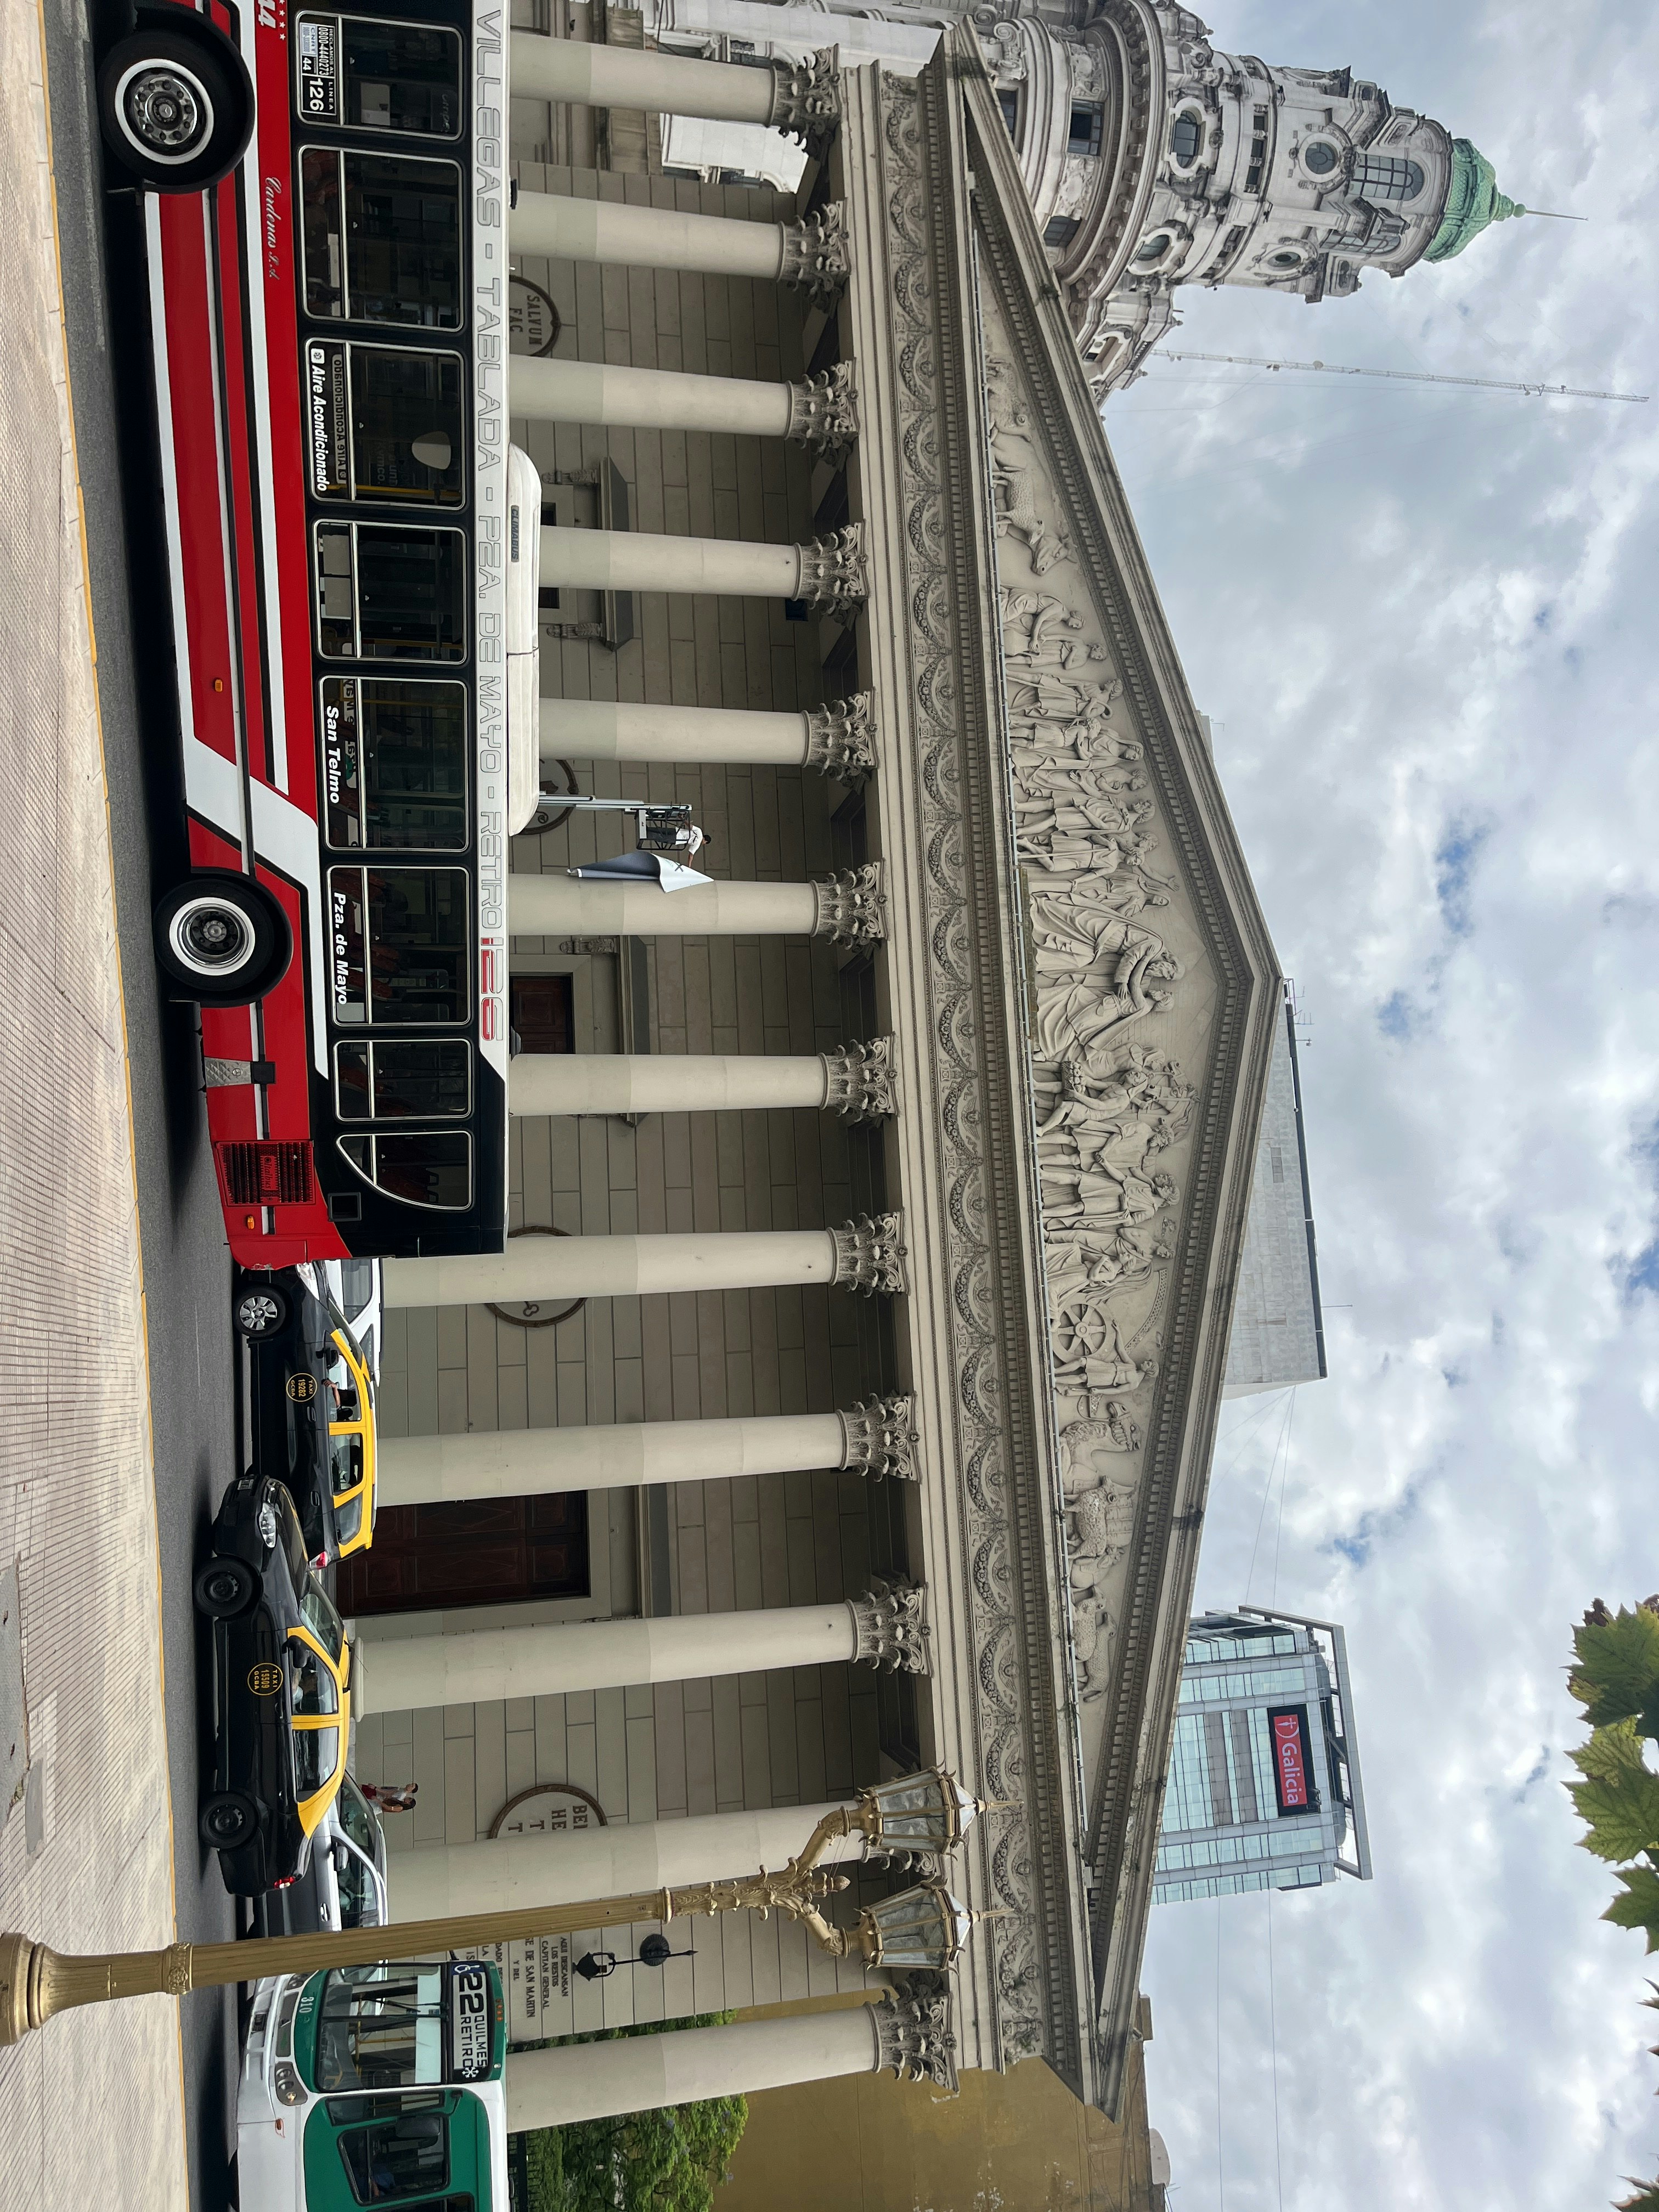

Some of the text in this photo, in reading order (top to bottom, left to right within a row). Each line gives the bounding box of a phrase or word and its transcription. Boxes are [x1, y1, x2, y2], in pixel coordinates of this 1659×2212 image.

[302, 57, 312, 71] 44
[318, 27, 329, 76] 0800-4440273
[329, 66, 335, 75] AL
[309, 77, 324, 111] 126
[476, 9, 501, 228] VILLEGAS
[264, 177, 282, 248] Cardenas
[509, 307, 524, 333] FAC
[477, 277, 501, 472] TABLADA
[312, 365, 330, 492] Aire Acondicionado
[479, 613, 501, 663] DE
[479, 675, 501, 774] MAYO
[326, 706, 342, 804] San Telmo
[481, 811, 502, 929] RETIRO
[334, 892, 349, 1005] Pza. de Mayo
[480, 936, 504, 1042] 126
[298, 1379, 306, 1397] 19282
[261, 1669, 270, 1689] 15509
[1282, 1742, 1302, 1804] Galicia
[525, 1950, 534, 1962] DE
[526, 1965, 535, 1983] SAN
[298, 1996, 314, 2013] 310
[459, 1972, 487, 2067] 22 QUILMES
[526, 1986, 536, 2018] MARTIN
[460, 2016, 473, 2068] RETIRO
